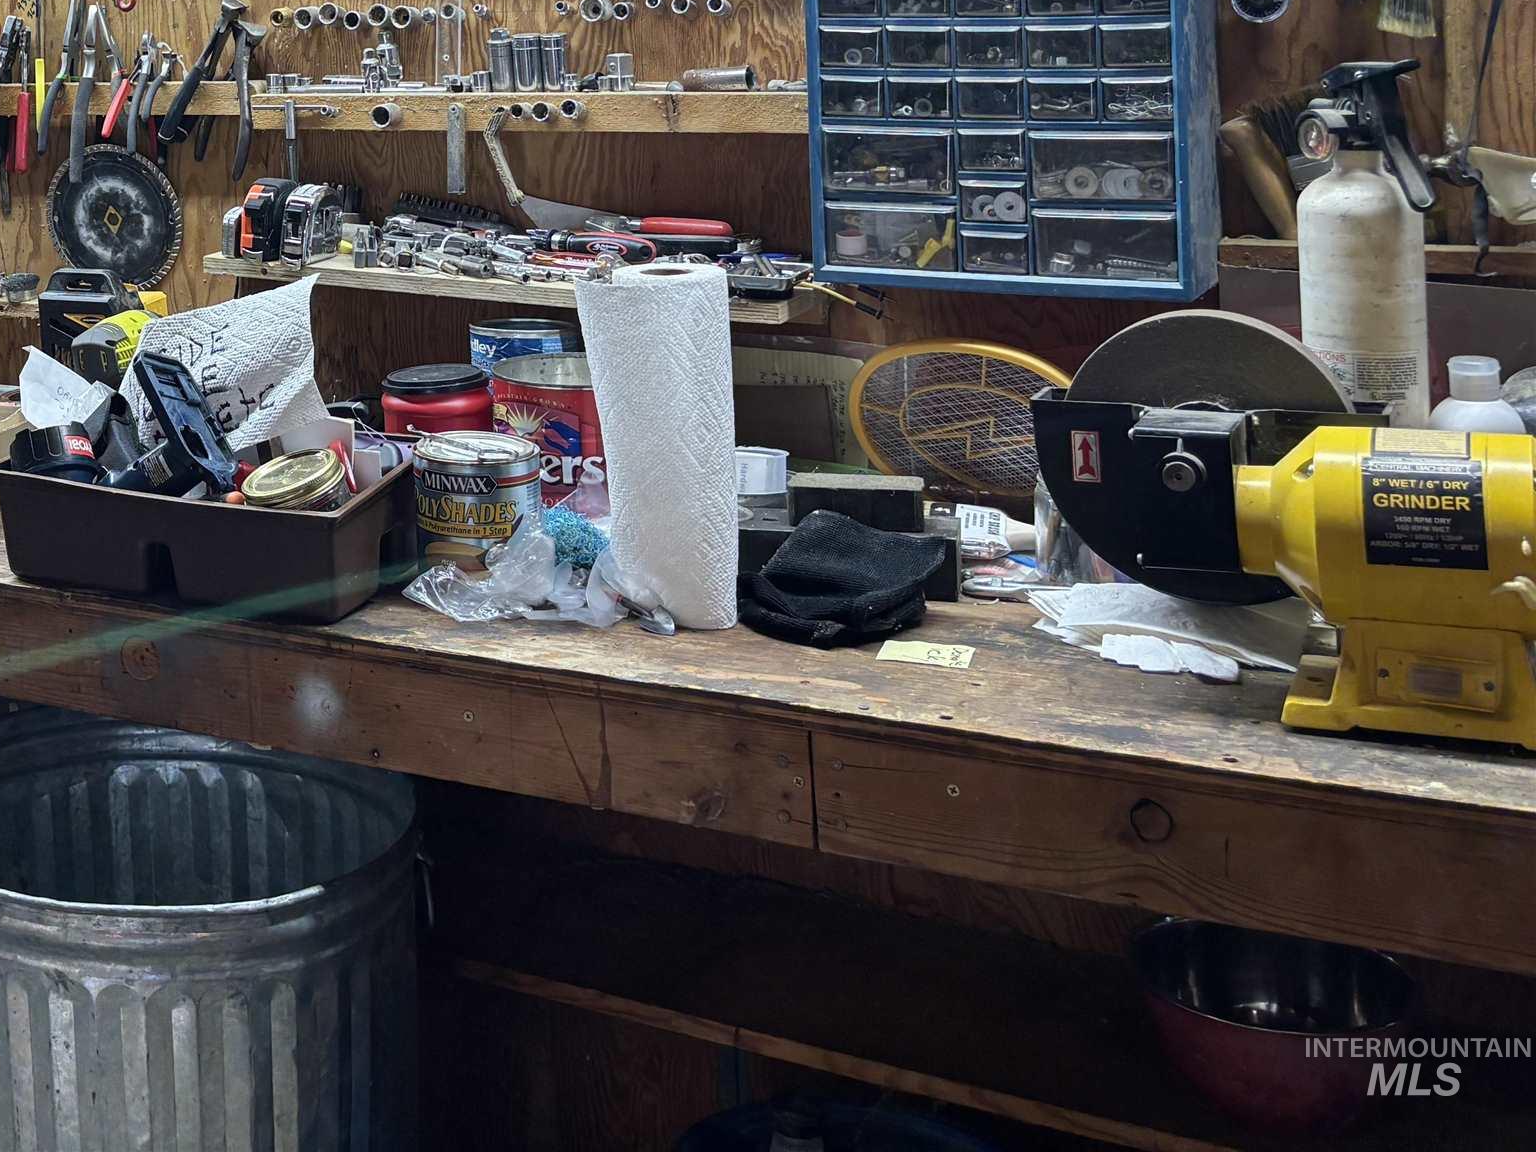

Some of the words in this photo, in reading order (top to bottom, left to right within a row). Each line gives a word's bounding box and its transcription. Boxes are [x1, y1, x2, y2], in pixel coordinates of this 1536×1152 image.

[424, 471, 490, 494] MINWAX
[1389, 479, 1416, 488] WET
[1443, 481, 1469, 490] DRY
[1373, 493, 1471, 511] GRINDER
[429, 523, 472, 535] Polyurethane
[473, 526, 481, 534] in
[489, 527, 508, 537] Step
